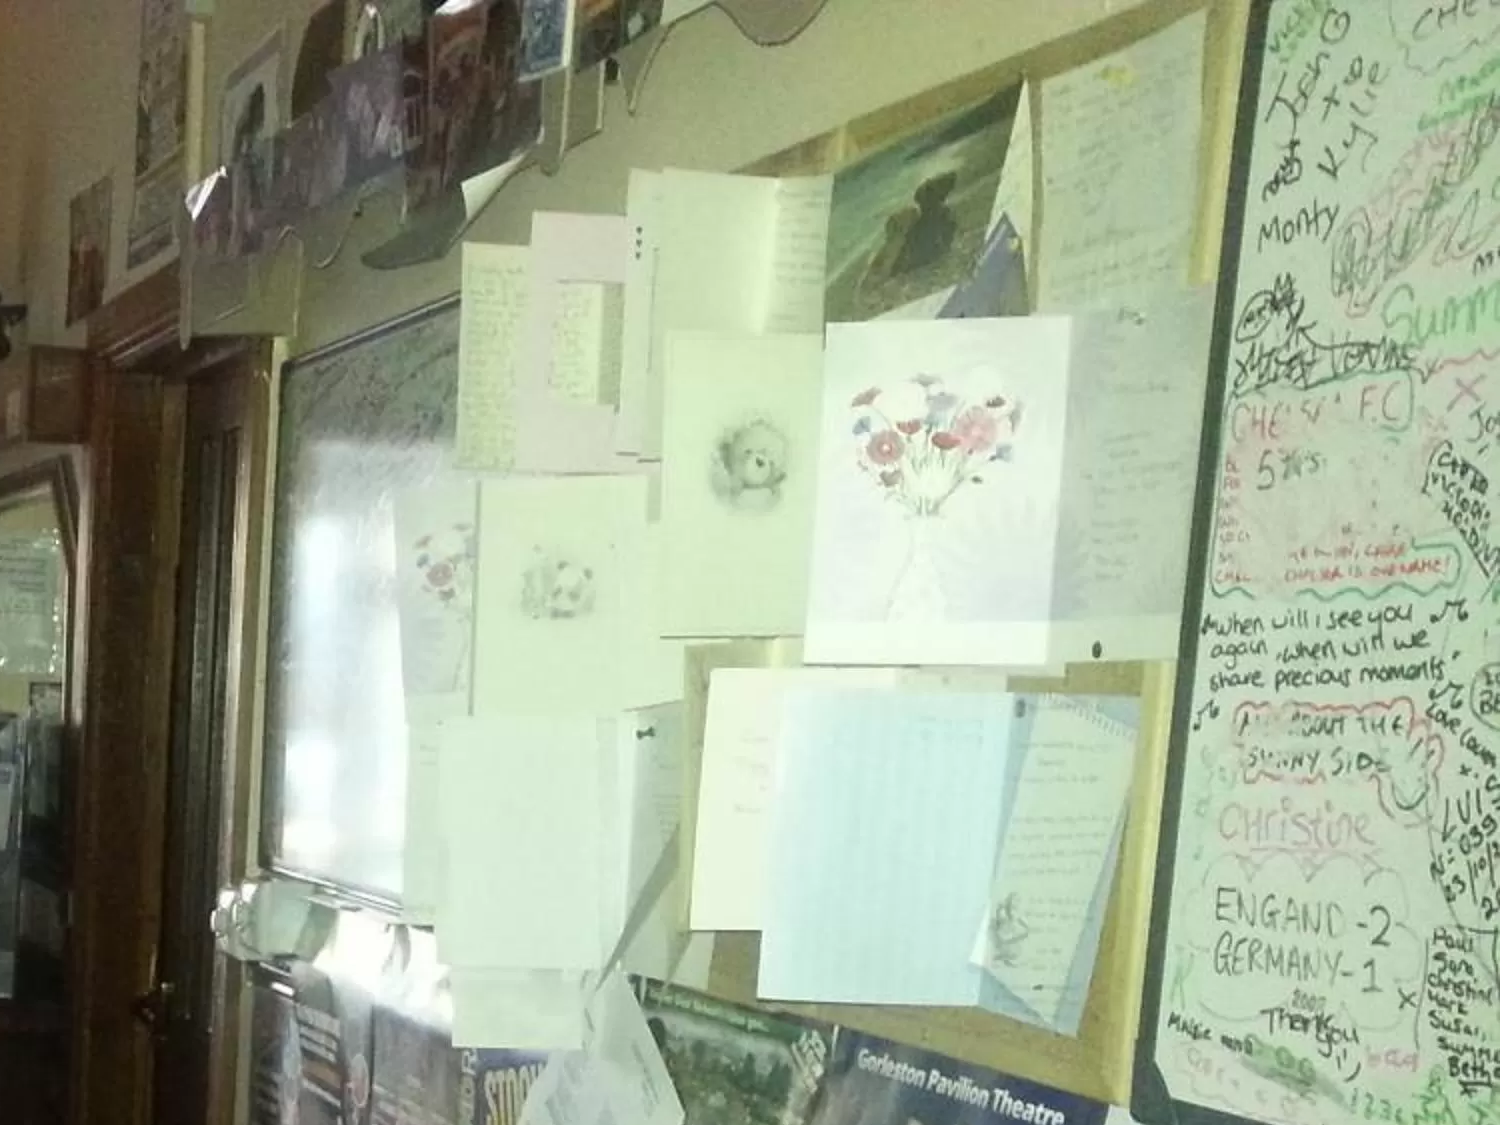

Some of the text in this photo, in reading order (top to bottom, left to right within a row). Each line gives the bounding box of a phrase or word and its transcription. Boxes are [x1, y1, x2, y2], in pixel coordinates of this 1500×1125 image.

[1257, 199, 1340, 252] Monty
[1271, 607, 1309, 630] will
[1326, 611, 1361, 629] see
[1367, 603, 1413, 650] you
[1393, 628, 1431, 650] we
[1209, 669, 1265, 693] share
[1274, 666, 1350, 692] precious
[1356, 714, 1403, 737] THE
[1214, 886, 1342, 940] ENGAND
[856, 1047, 928, 1089] Gorleston
[926, 1067, 990, 1111] Pavilion
